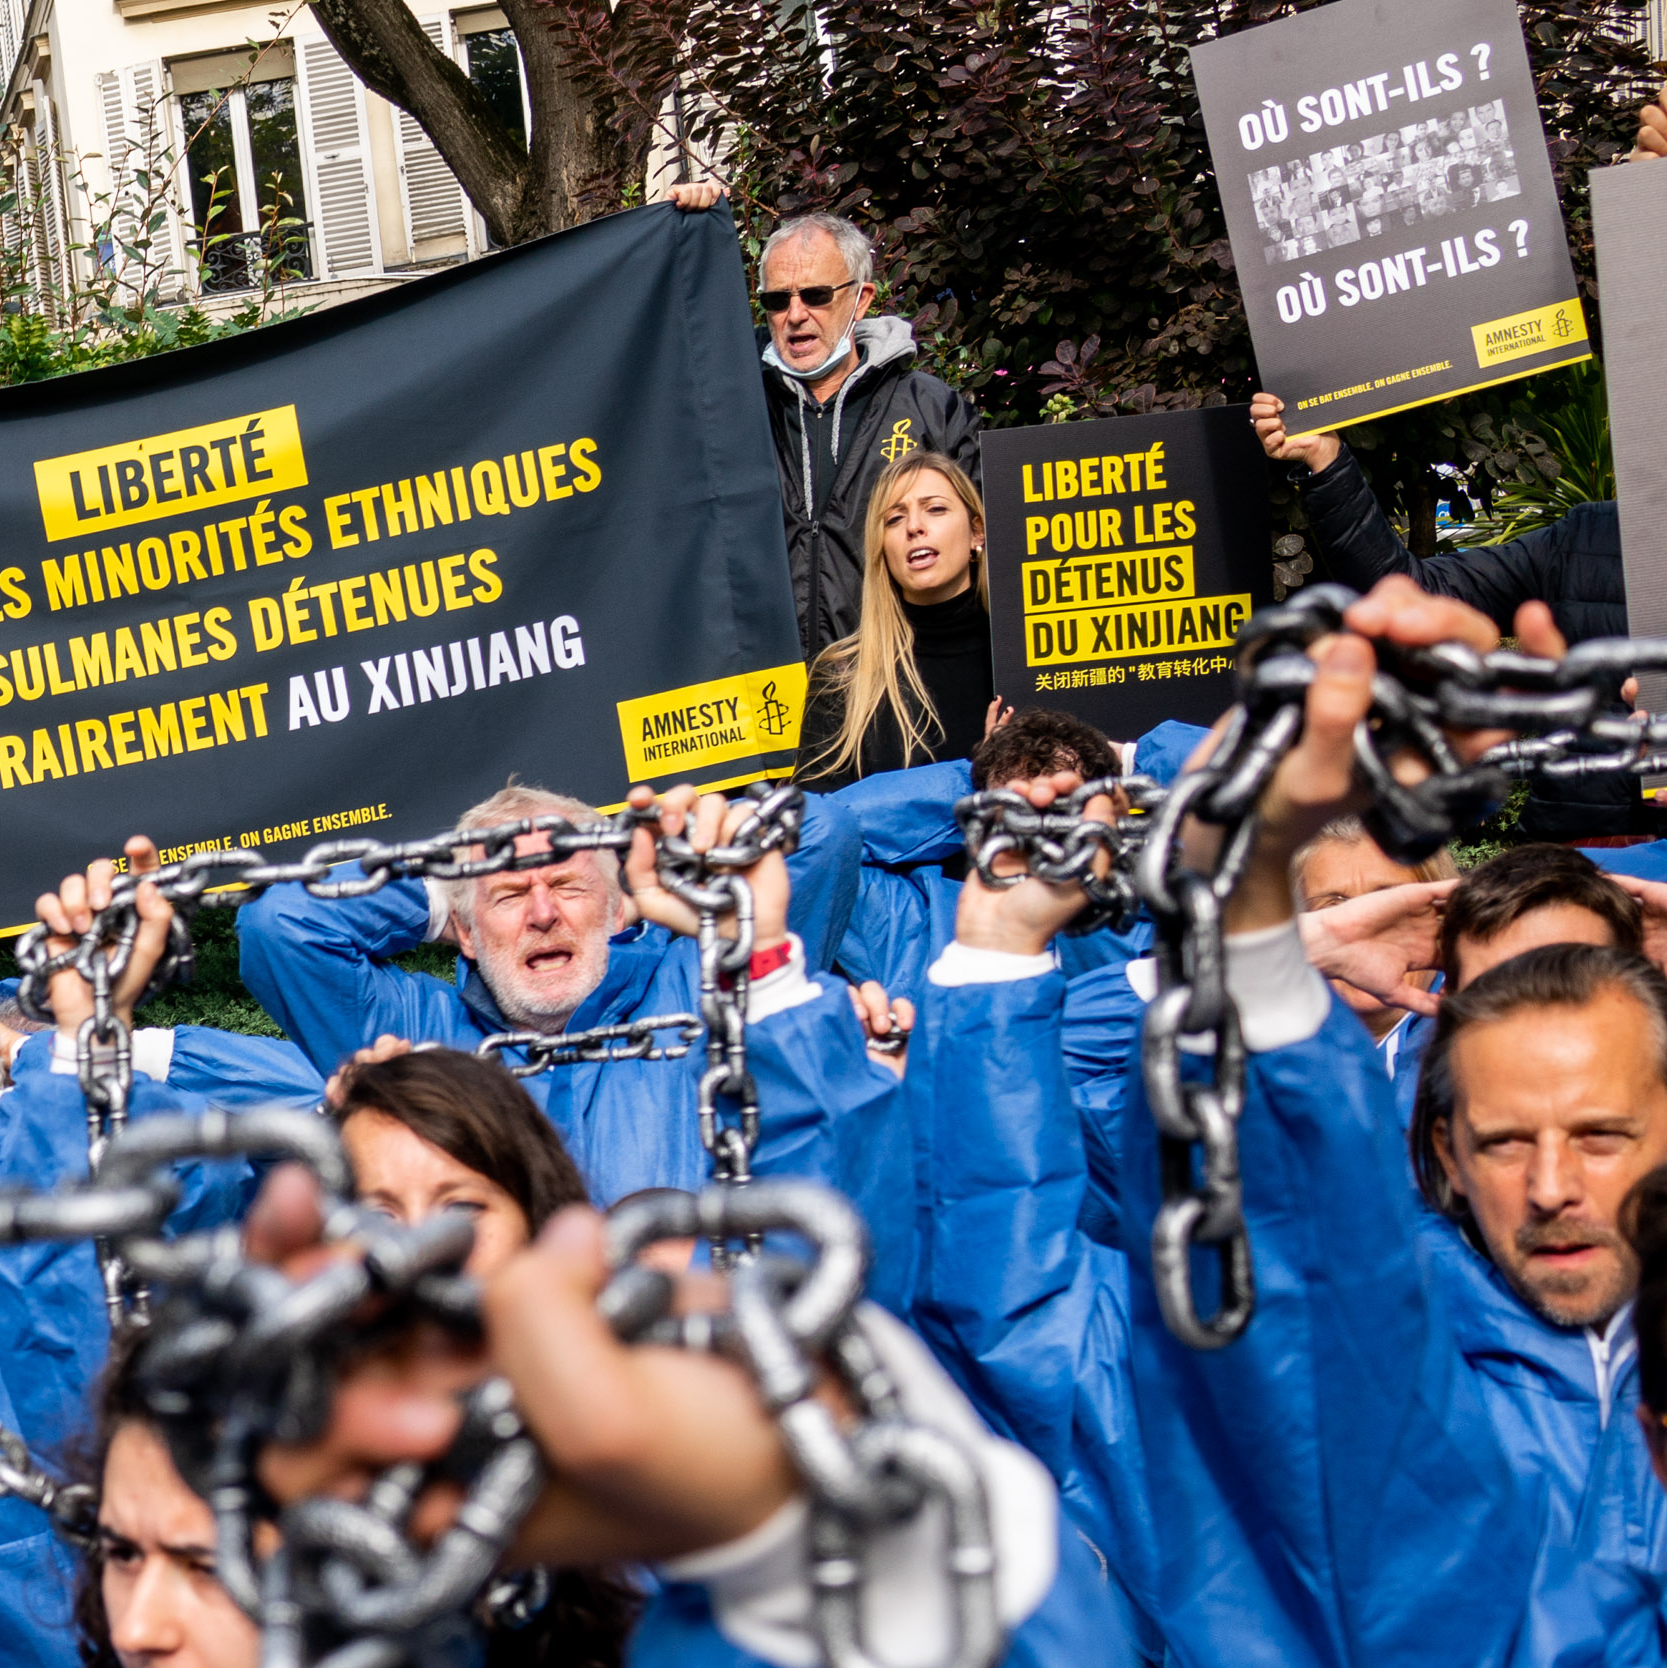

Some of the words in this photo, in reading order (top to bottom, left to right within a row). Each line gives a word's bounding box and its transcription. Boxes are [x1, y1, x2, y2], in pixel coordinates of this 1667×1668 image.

[1237, 99, 1289, 151] OÙ
[1296, 52, 1463, 134] SONT-ILS
[1470, 42, 1492, 81] ?
[1275, 271, 1327, 325] OÙ
[1334, 227, 1502, 308] SONT-ILS
[1507, 218, 1530, 259] ?
[1484, 318, 1543, 347] AMNESTY
[1486, 334, 1547, 358] INTERNATIONAL
[1297, 401, 1308, 410] ON
[1309, 398, 1318, 407] SE
[1319, 393, 1333, 405] BAT
[1374, 378, 1385, 389] ON
[1385, 371, 1411, 386] GAGNE
[1411, 360, 1454, 378] ENSEMBLE.
[69, 417, 273, 521] LIBERTÉ
[1021, 441, 1167, 503] LIBERTÉ
[41, 497, 314, 613] MINORITÉS
[324, 436, 603, 550] ETHNIQUES
[1025, 508, 1123, 555] POUR
[1134, 500, 1197, 544] LES
[250, 547, 503, 655] DÉTENUES
[1030, 554, 1185, 606] DÉTENUS
[1033, 619, 1079, 660] DU
[1091, 601, 1245, 654] XINJIANG
[285, 680, 352, 733] AU
[366, 614, 586, 716] XINJIANG
[642, 696, 738, 742] AMNESTY
[643, 726, 746, 762] INTERNATIONAL
[240, 830, 261, 849] ON
[263, 819, 311, 844] GAGNE
[312, 803, 393, 835] ENSEMBLE.
